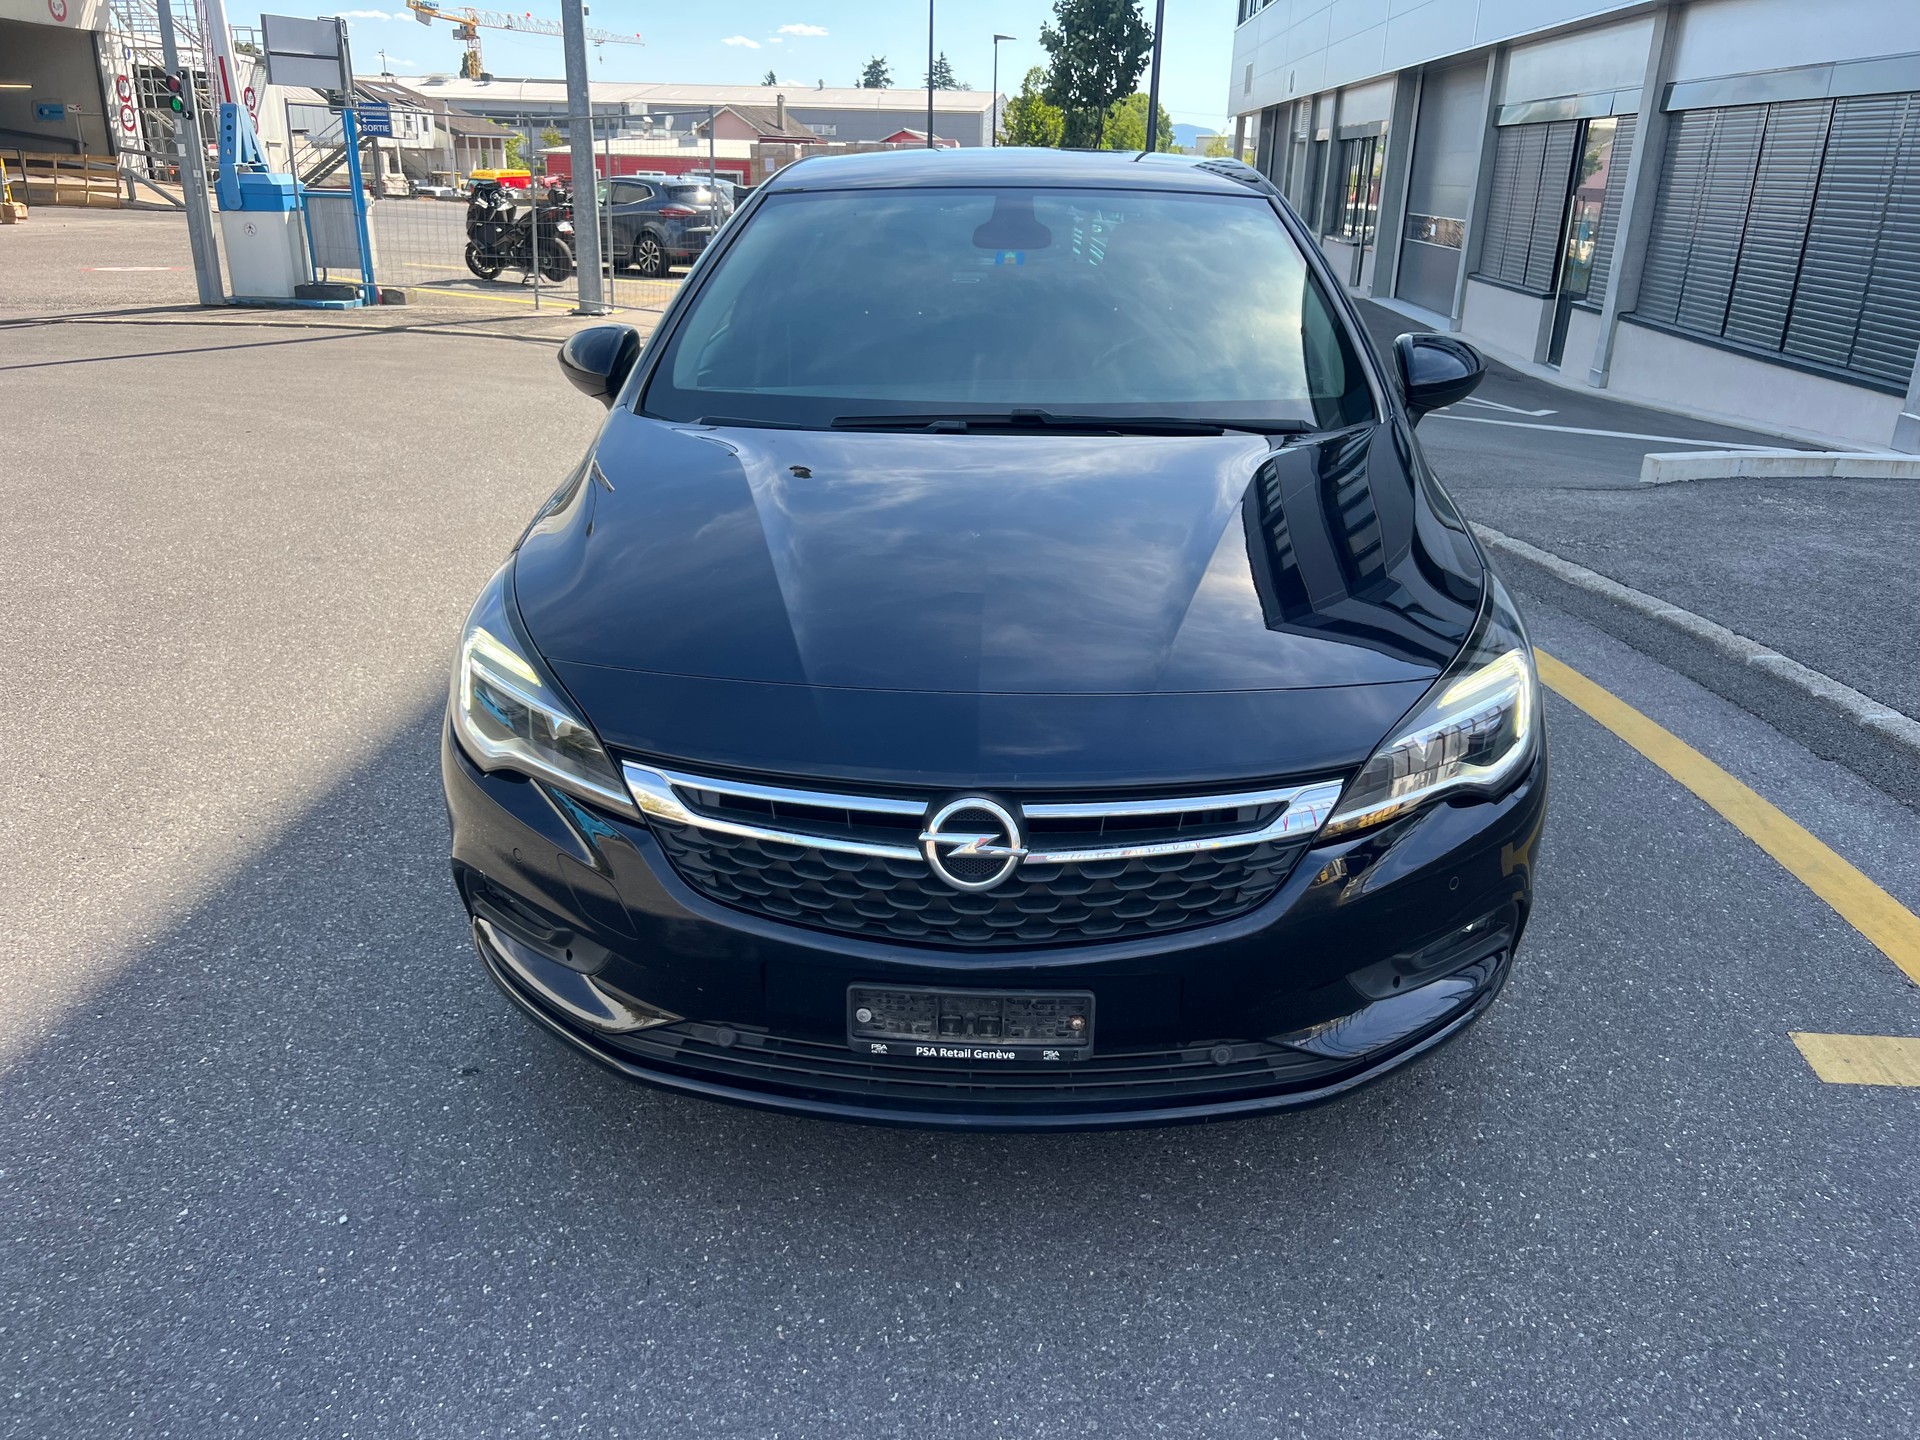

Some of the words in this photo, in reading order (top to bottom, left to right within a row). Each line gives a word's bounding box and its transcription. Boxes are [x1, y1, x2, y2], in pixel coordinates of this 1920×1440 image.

[916, 1046, 937, 1057] PSA
[940, 1048, 971, 1058] Retail
[973, 1049, 1016, 1059] Genève
